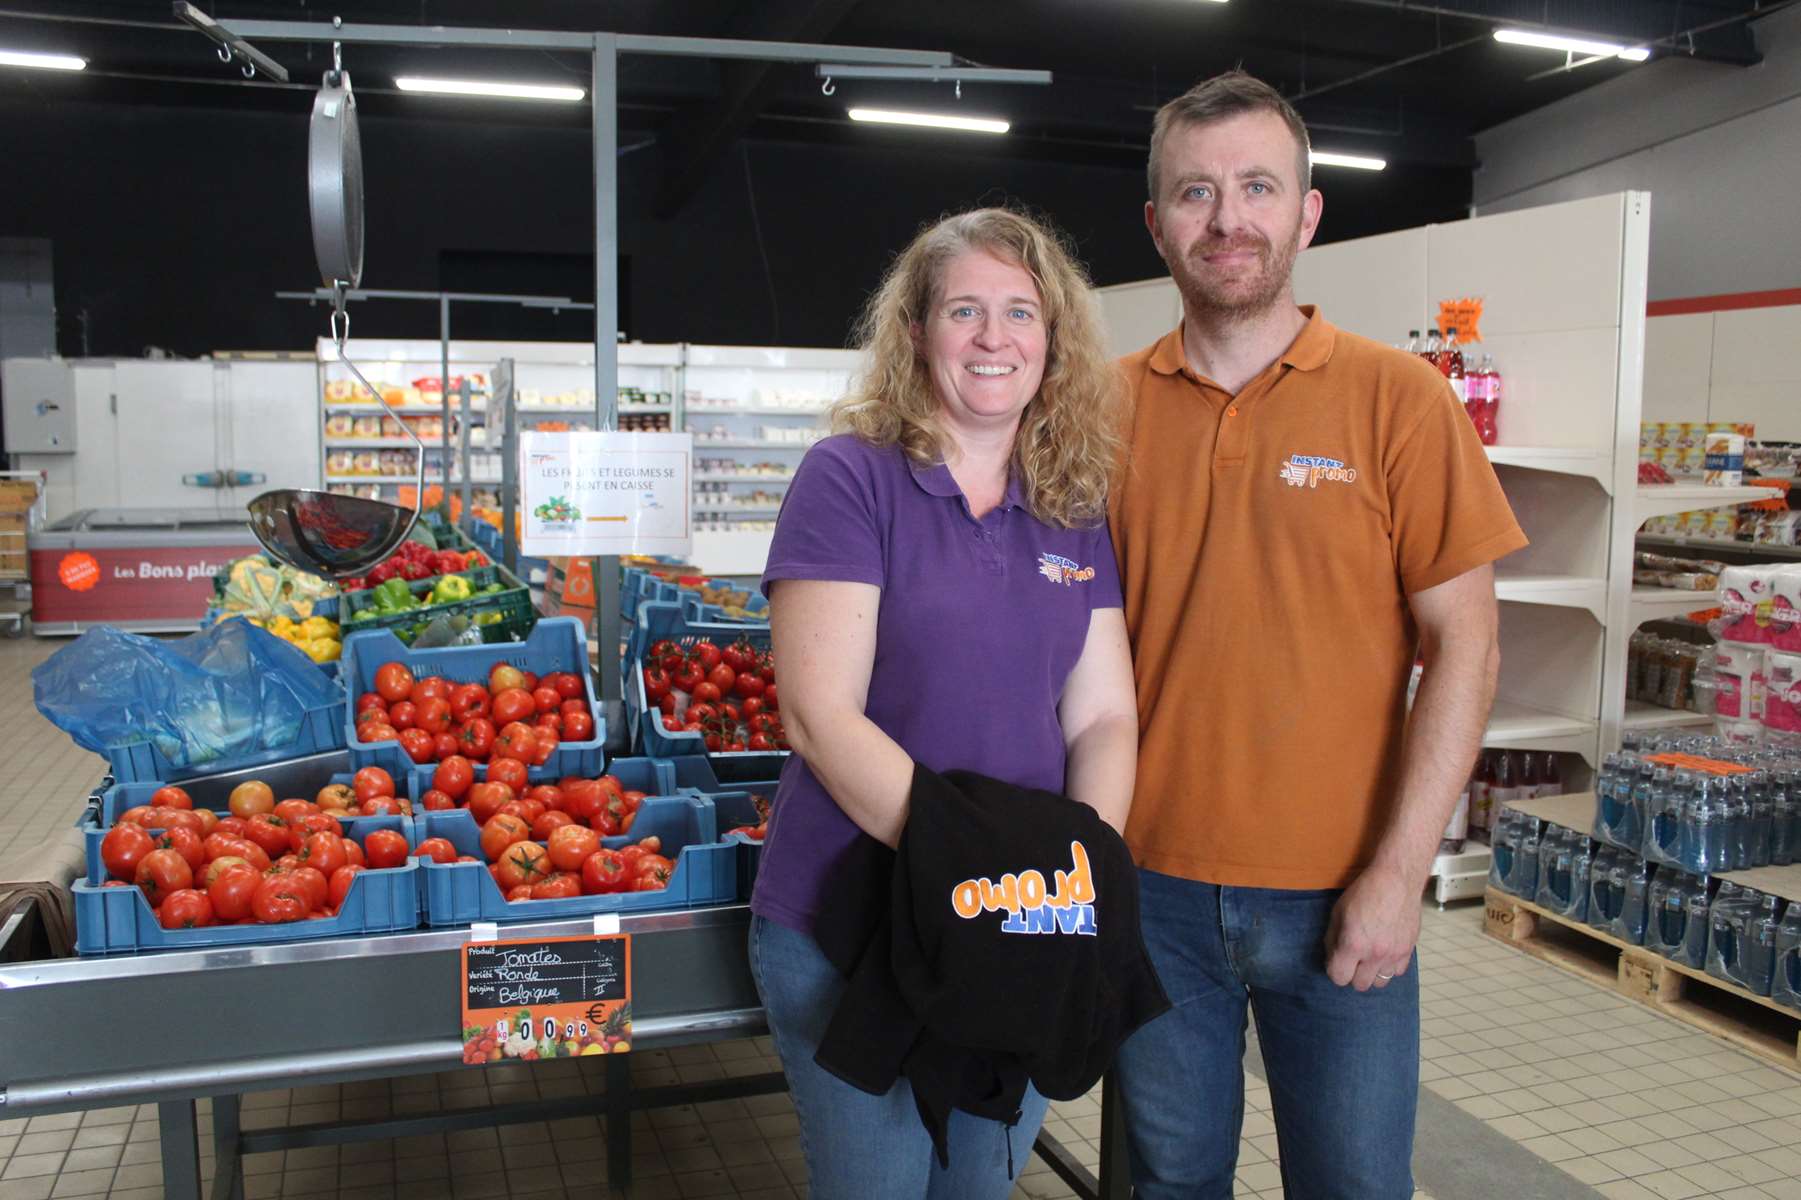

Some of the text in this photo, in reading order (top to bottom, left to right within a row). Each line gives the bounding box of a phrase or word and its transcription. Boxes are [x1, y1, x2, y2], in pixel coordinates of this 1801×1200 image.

[1290, 454, 1345, 469] INSTANT
[542, 467, 559, 478] LES
[599, 467, 609, 478] ET
[613, 467, 662, 478] LEGUMES
[663, 467, 676, 479] SE
[1309, 467, 1357, 488] promo
[563, 480, 654, 490] PSNT EN CAISSE
[114, 566, 136, 578] Les
[139, 562, 184, 579] Bons
[187, 561, 222, 582] pla
[952, 840, 1096, 919] promo
[1001, 903, 1098, 936] TANT
[468, 947, 562, 967] Produit Tomates
[468, 967, 541, 981] Variété Ronde
[468, 984, 561, 1004] Origine Belgique
[585, 1003, 607, 1025] €
[497, 1031, 508, 1041] kg
